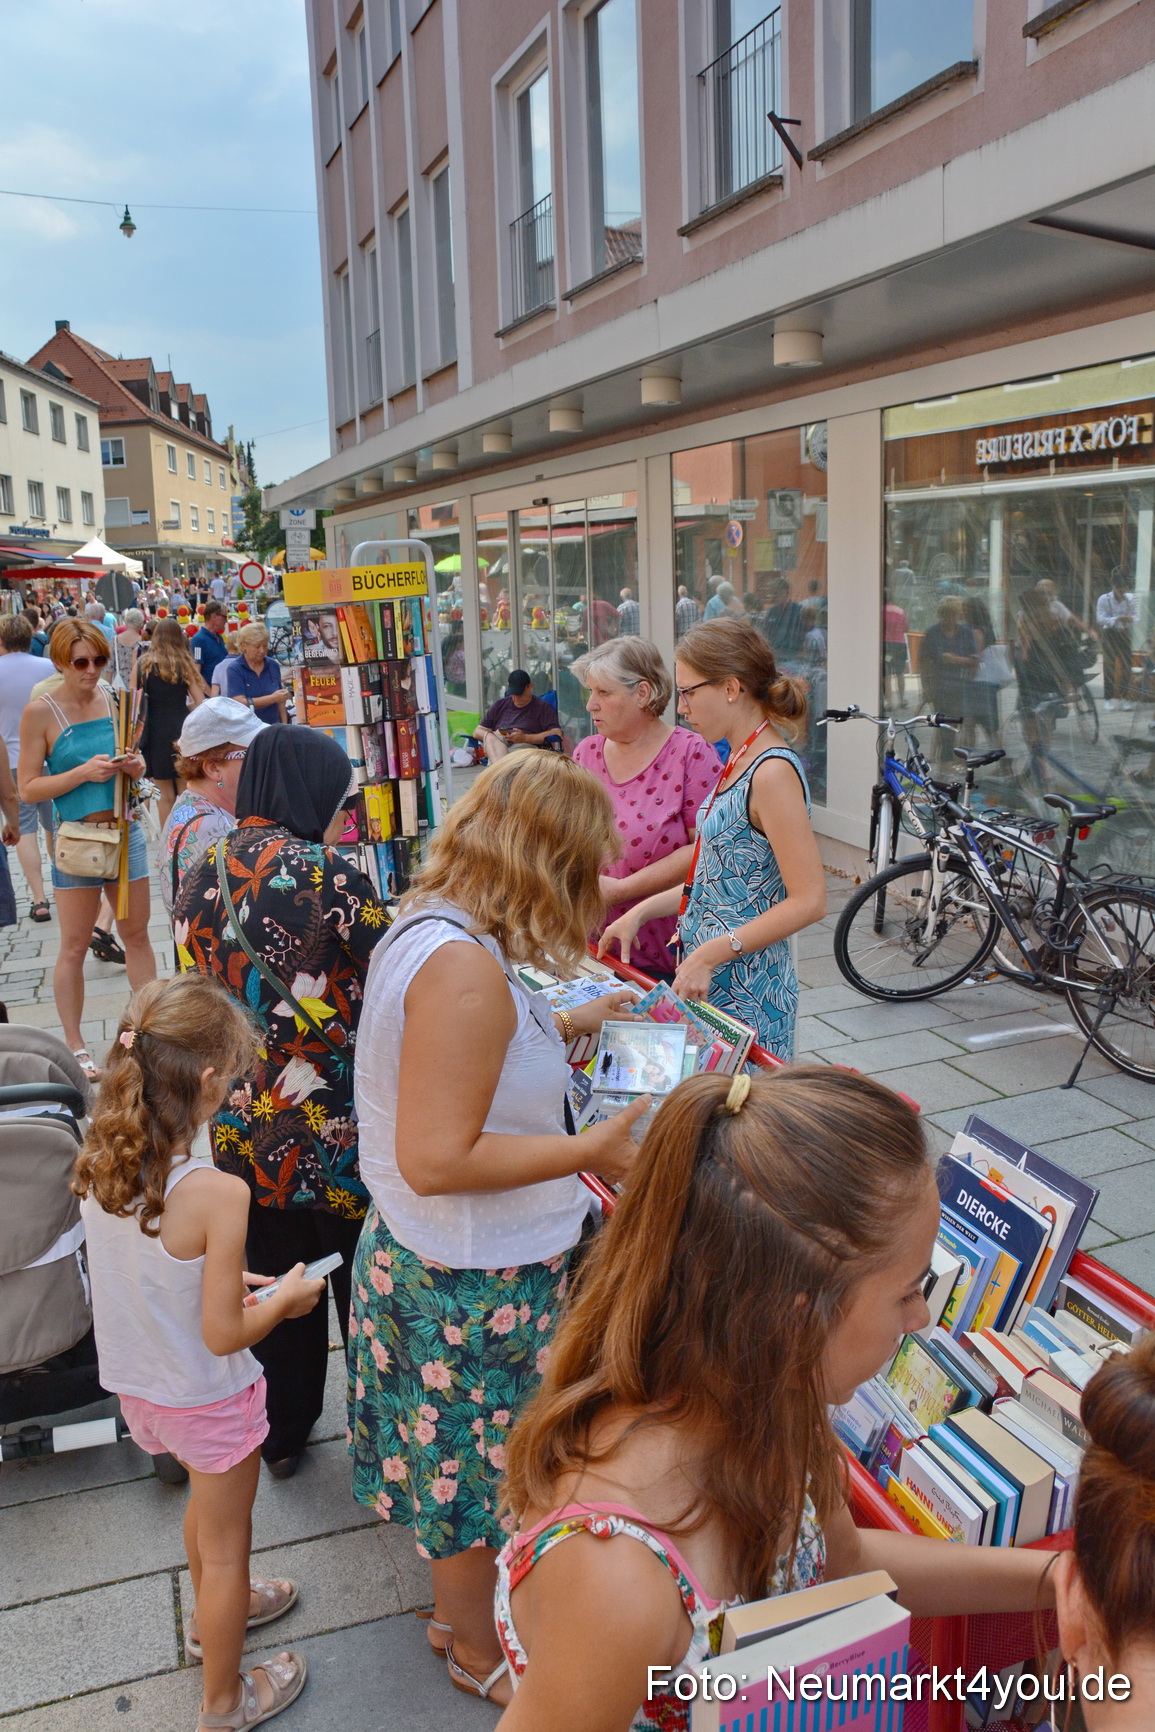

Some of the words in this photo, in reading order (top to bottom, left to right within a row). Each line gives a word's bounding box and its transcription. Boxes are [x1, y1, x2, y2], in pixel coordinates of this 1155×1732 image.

[309, 674, 337, 687] FEUER
[956, 1188, 1012, 1241] DIERCKE
[955, 1222, 965, 1233] DER
[964, 1230, 977, 1242] WELT
[1024, 1389, 1061, 1420] MICHAEL
[906, 1475, 934, 1513] HANNI
[936, 1511, 955, 1535] UND
[829, 1648, 867, 1670] BerryBlue
